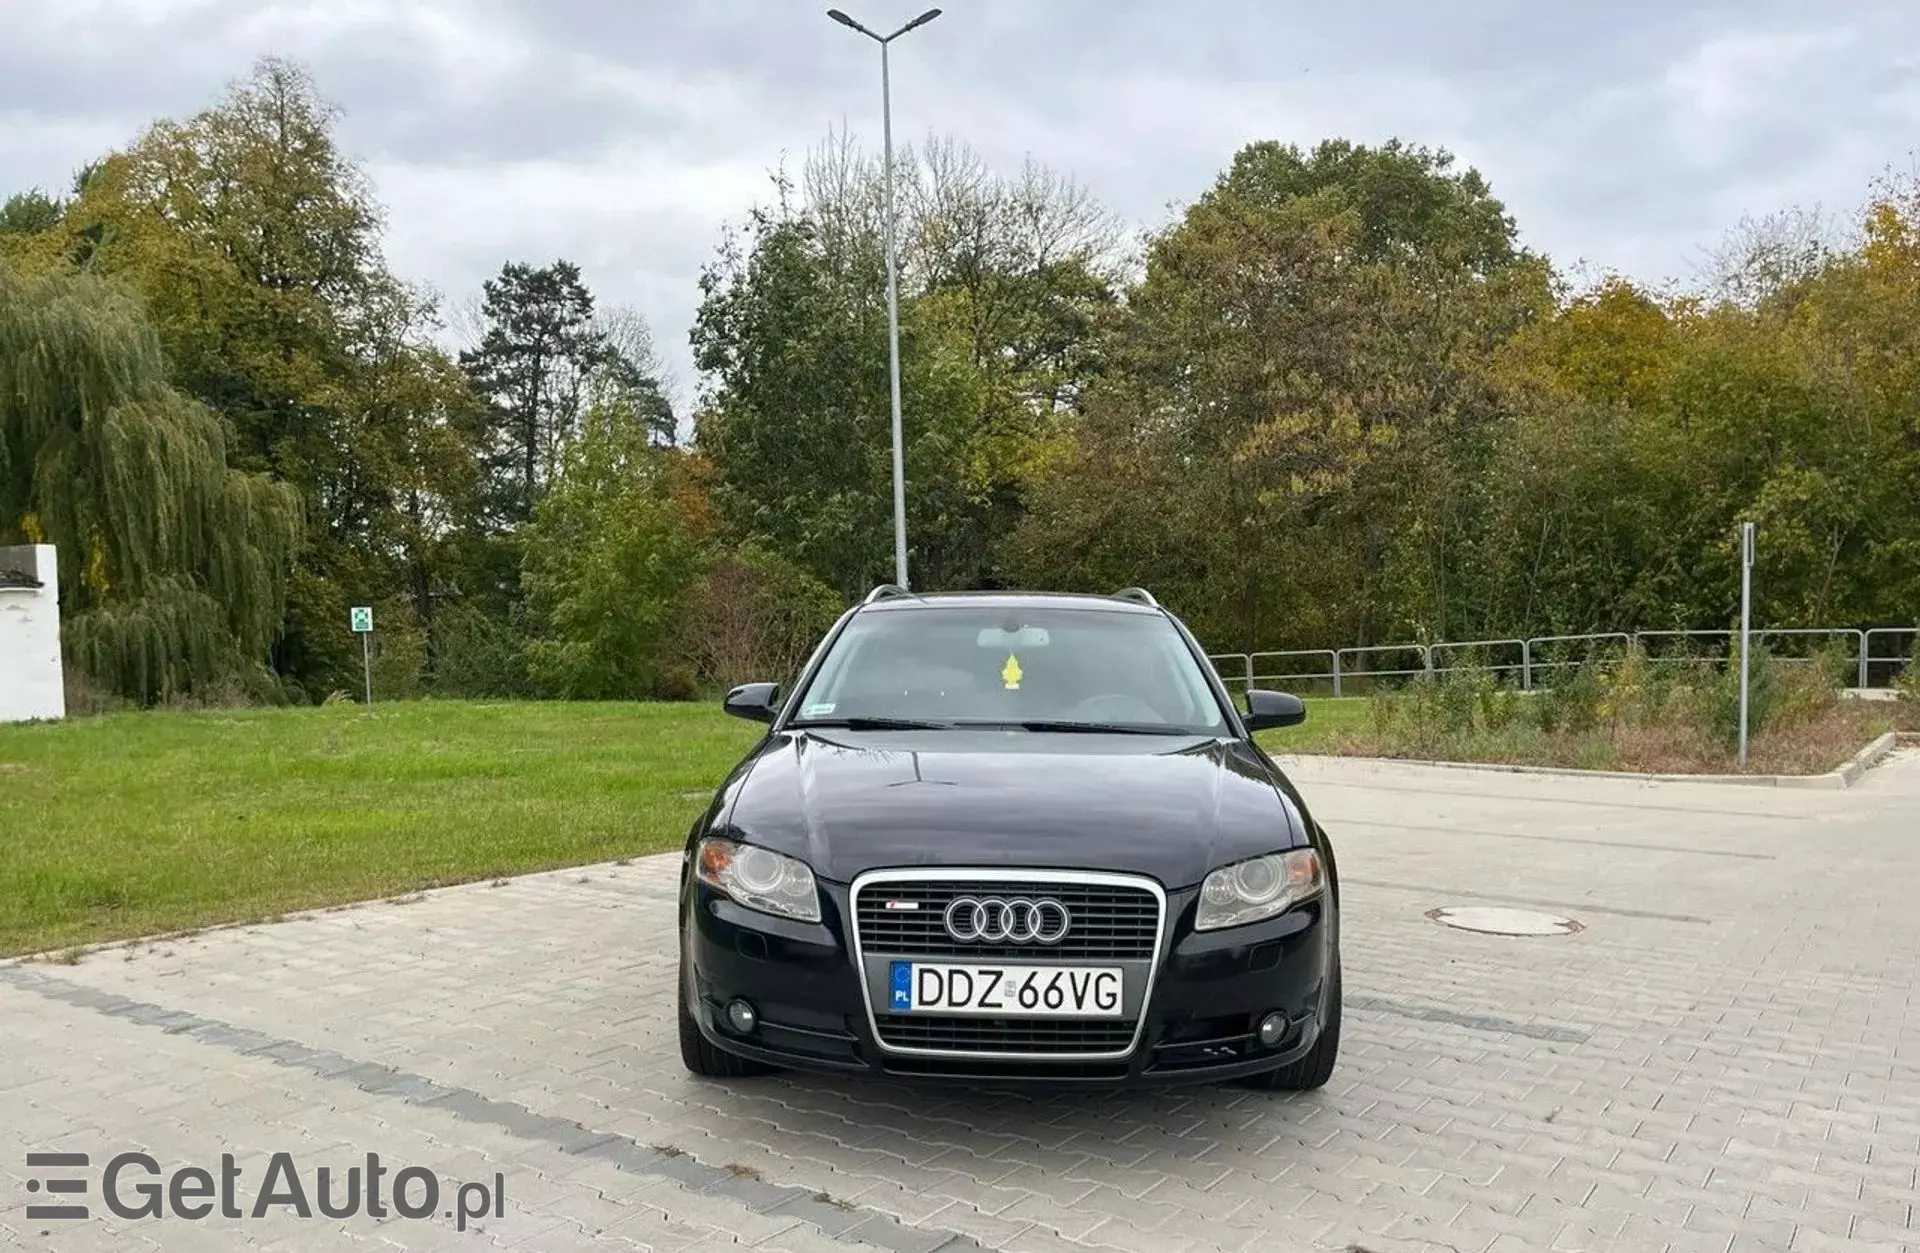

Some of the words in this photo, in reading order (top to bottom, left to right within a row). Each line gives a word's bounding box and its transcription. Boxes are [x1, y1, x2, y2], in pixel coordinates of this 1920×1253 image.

[895, 991, 910, 1002] PL
[918, 967, 1004, 1008] DDZ
[1018, 971, 1118, 1010] 66VG
